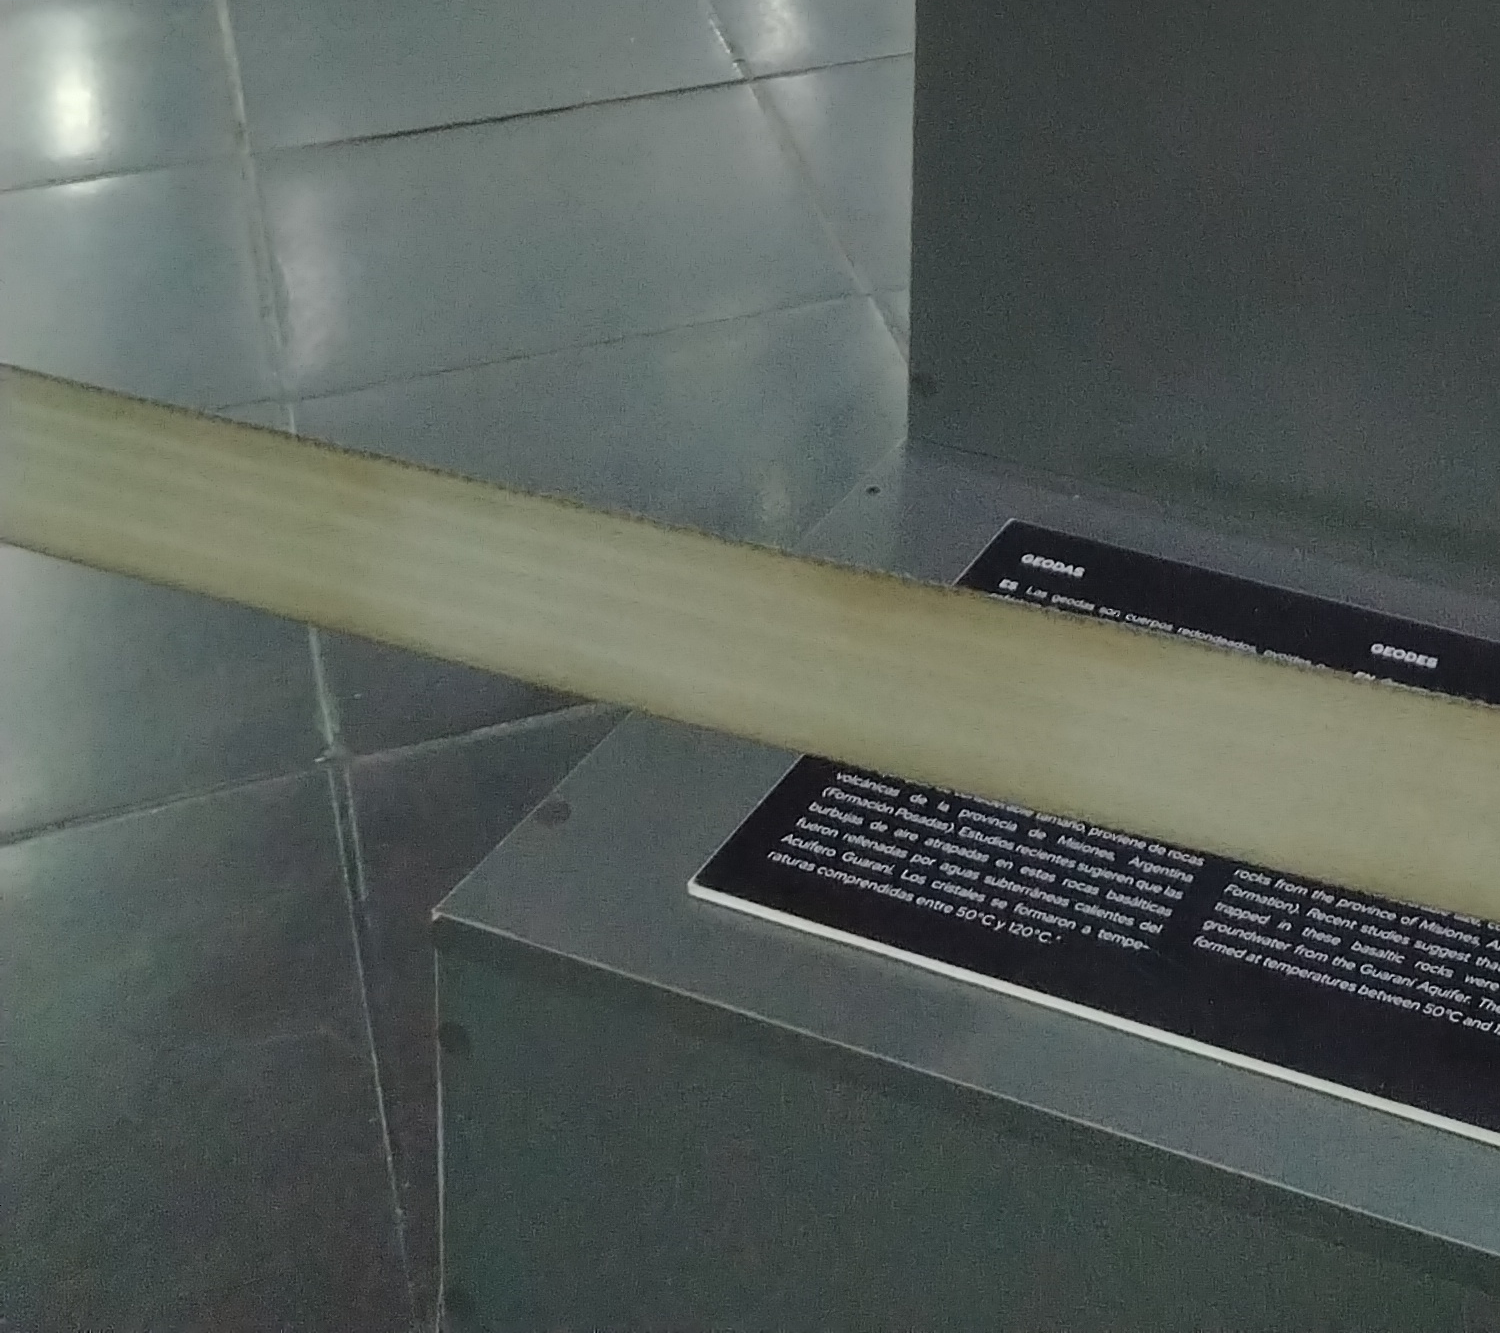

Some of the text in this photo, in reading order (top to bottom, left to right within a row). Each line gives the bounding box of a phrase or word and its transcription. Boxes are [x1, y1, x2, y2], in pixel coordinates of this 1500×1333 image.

[1021, 553, 1086, 578] GEODAS
[1370, 643, 1438, 669] GEODES
[808, 801, 1174, 919] burbujas de aire atrapadas en estas rocas basálticas
[836, 772, 900, 797] volcánicas
[910, 793, 928, 806] de
[937, 801, 950, 813] la
[958, 809, 1018, 832] provincia
[1028, 828, 1047, 840] de
[1128, 855, 1194, 884] Argentina
[958, 826, 1016, 851] Estudios
[1016, 843, 1077, 869] recientes
[1077, 861, 1134, 887] sugieren
[1136, 879, 1163, 895] que
[1163, 886, 1185, 901] las
[1148, 842, 1166, 855] de
[1168, 849, 1206, 867] rocas
[767, 850, 815, 873] raturas
[816, 865, 914, 902] comprendidas
[916, 896, 954, 914] entre
[955, 905, 995, 927] 50°C
[994, 920, 1006, 931] y
[780, 833, 836, 857] Acuífero
[900, 869, 927, 885] Los
[931, 879, 986, 903] cristales
[990, 897, 1008, 909] se
[1013, 901, 1077, 930] formaron
[1081, 924, 1092, 934] a
[1098, 929, 1150, 951] tempe-
[795, 816, 1164, 934] fueron rellenadas por aguas subterráneas calientes del
[1233, 869, 1272, 886] rocks
[1274, 879, 1308, 895] from
[1310, 889, 1335, 904] the
[1335, 898, 1397, 921] province
[1400, 915, 1420, 925] of
[1202, 919, 1293, 952] groundwater
[1294, 944, 1329, 963] from
[1332, 955, 1356, 971] the
[1416, 980, 1472, 1005] Aquifer.
[1214, 901, 1272, 926] trapped
[1276, 919, 1292, 932] in
[1301, 927, 1342, 947] these
[1350, 941, 1406, 965] basaltic
[1414, 959, 1455, 979] rocks
[1465, 974, 1500, 993] were
[1306, 907, 1358, 930] Recent
[1360, 923, 1410, 946] studies
[1414, 938, 1472, 963] suggest
[1192, 935, 1247, 959] formed
[1245, 952, 1262, 965] at
[1262, 957, 1358, 993] temperatures
[1358, 984, 1422, 1012] between
[1422, 1003, 1464, 1023] 50°C
[1462, 1013, 1494, 1033] and
